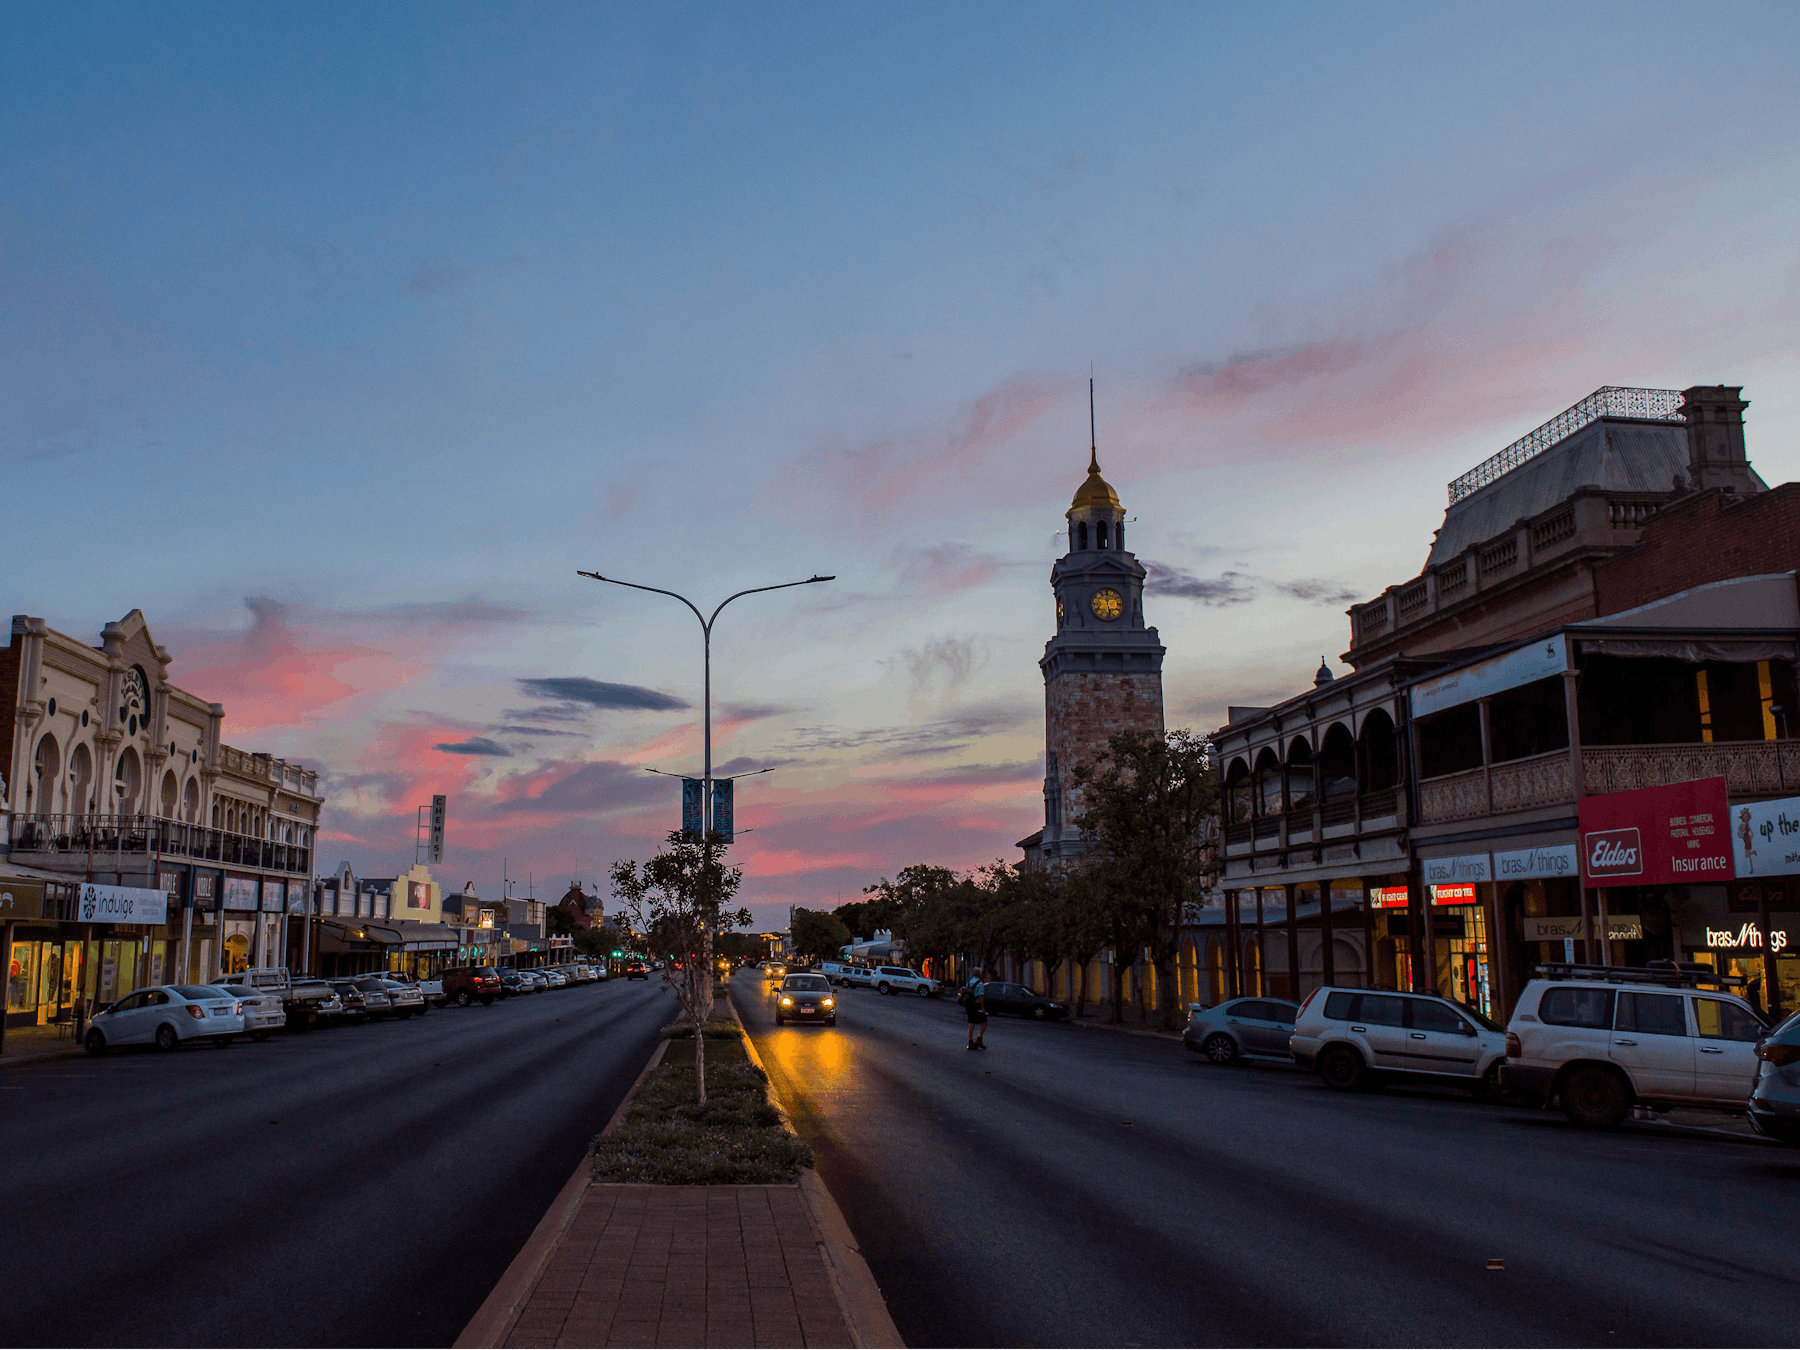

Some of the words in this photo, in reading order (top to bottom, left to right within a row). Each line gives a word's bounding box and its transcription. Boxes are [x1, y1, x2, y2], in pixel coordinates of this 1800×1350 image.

[434, 798, 443, 861] CHEMIST
[1760, 820, 1774, 843] up
[1778, 812, 1800, 836] the
[1501, 856, 1523, 874] bras
[1537, 851, 1570, 875] things
[1590, 840, 1638, 868] Elders
[1671, 855, 1727, 873] Insurance
[1428, 864, 1447, 880] bras
[1458, 860, 1485, 881] things
[98, 890, 134, 920] indulge
[1536, 922, 1566, 936] bras
[1706, 926, 1733, 948] bras
